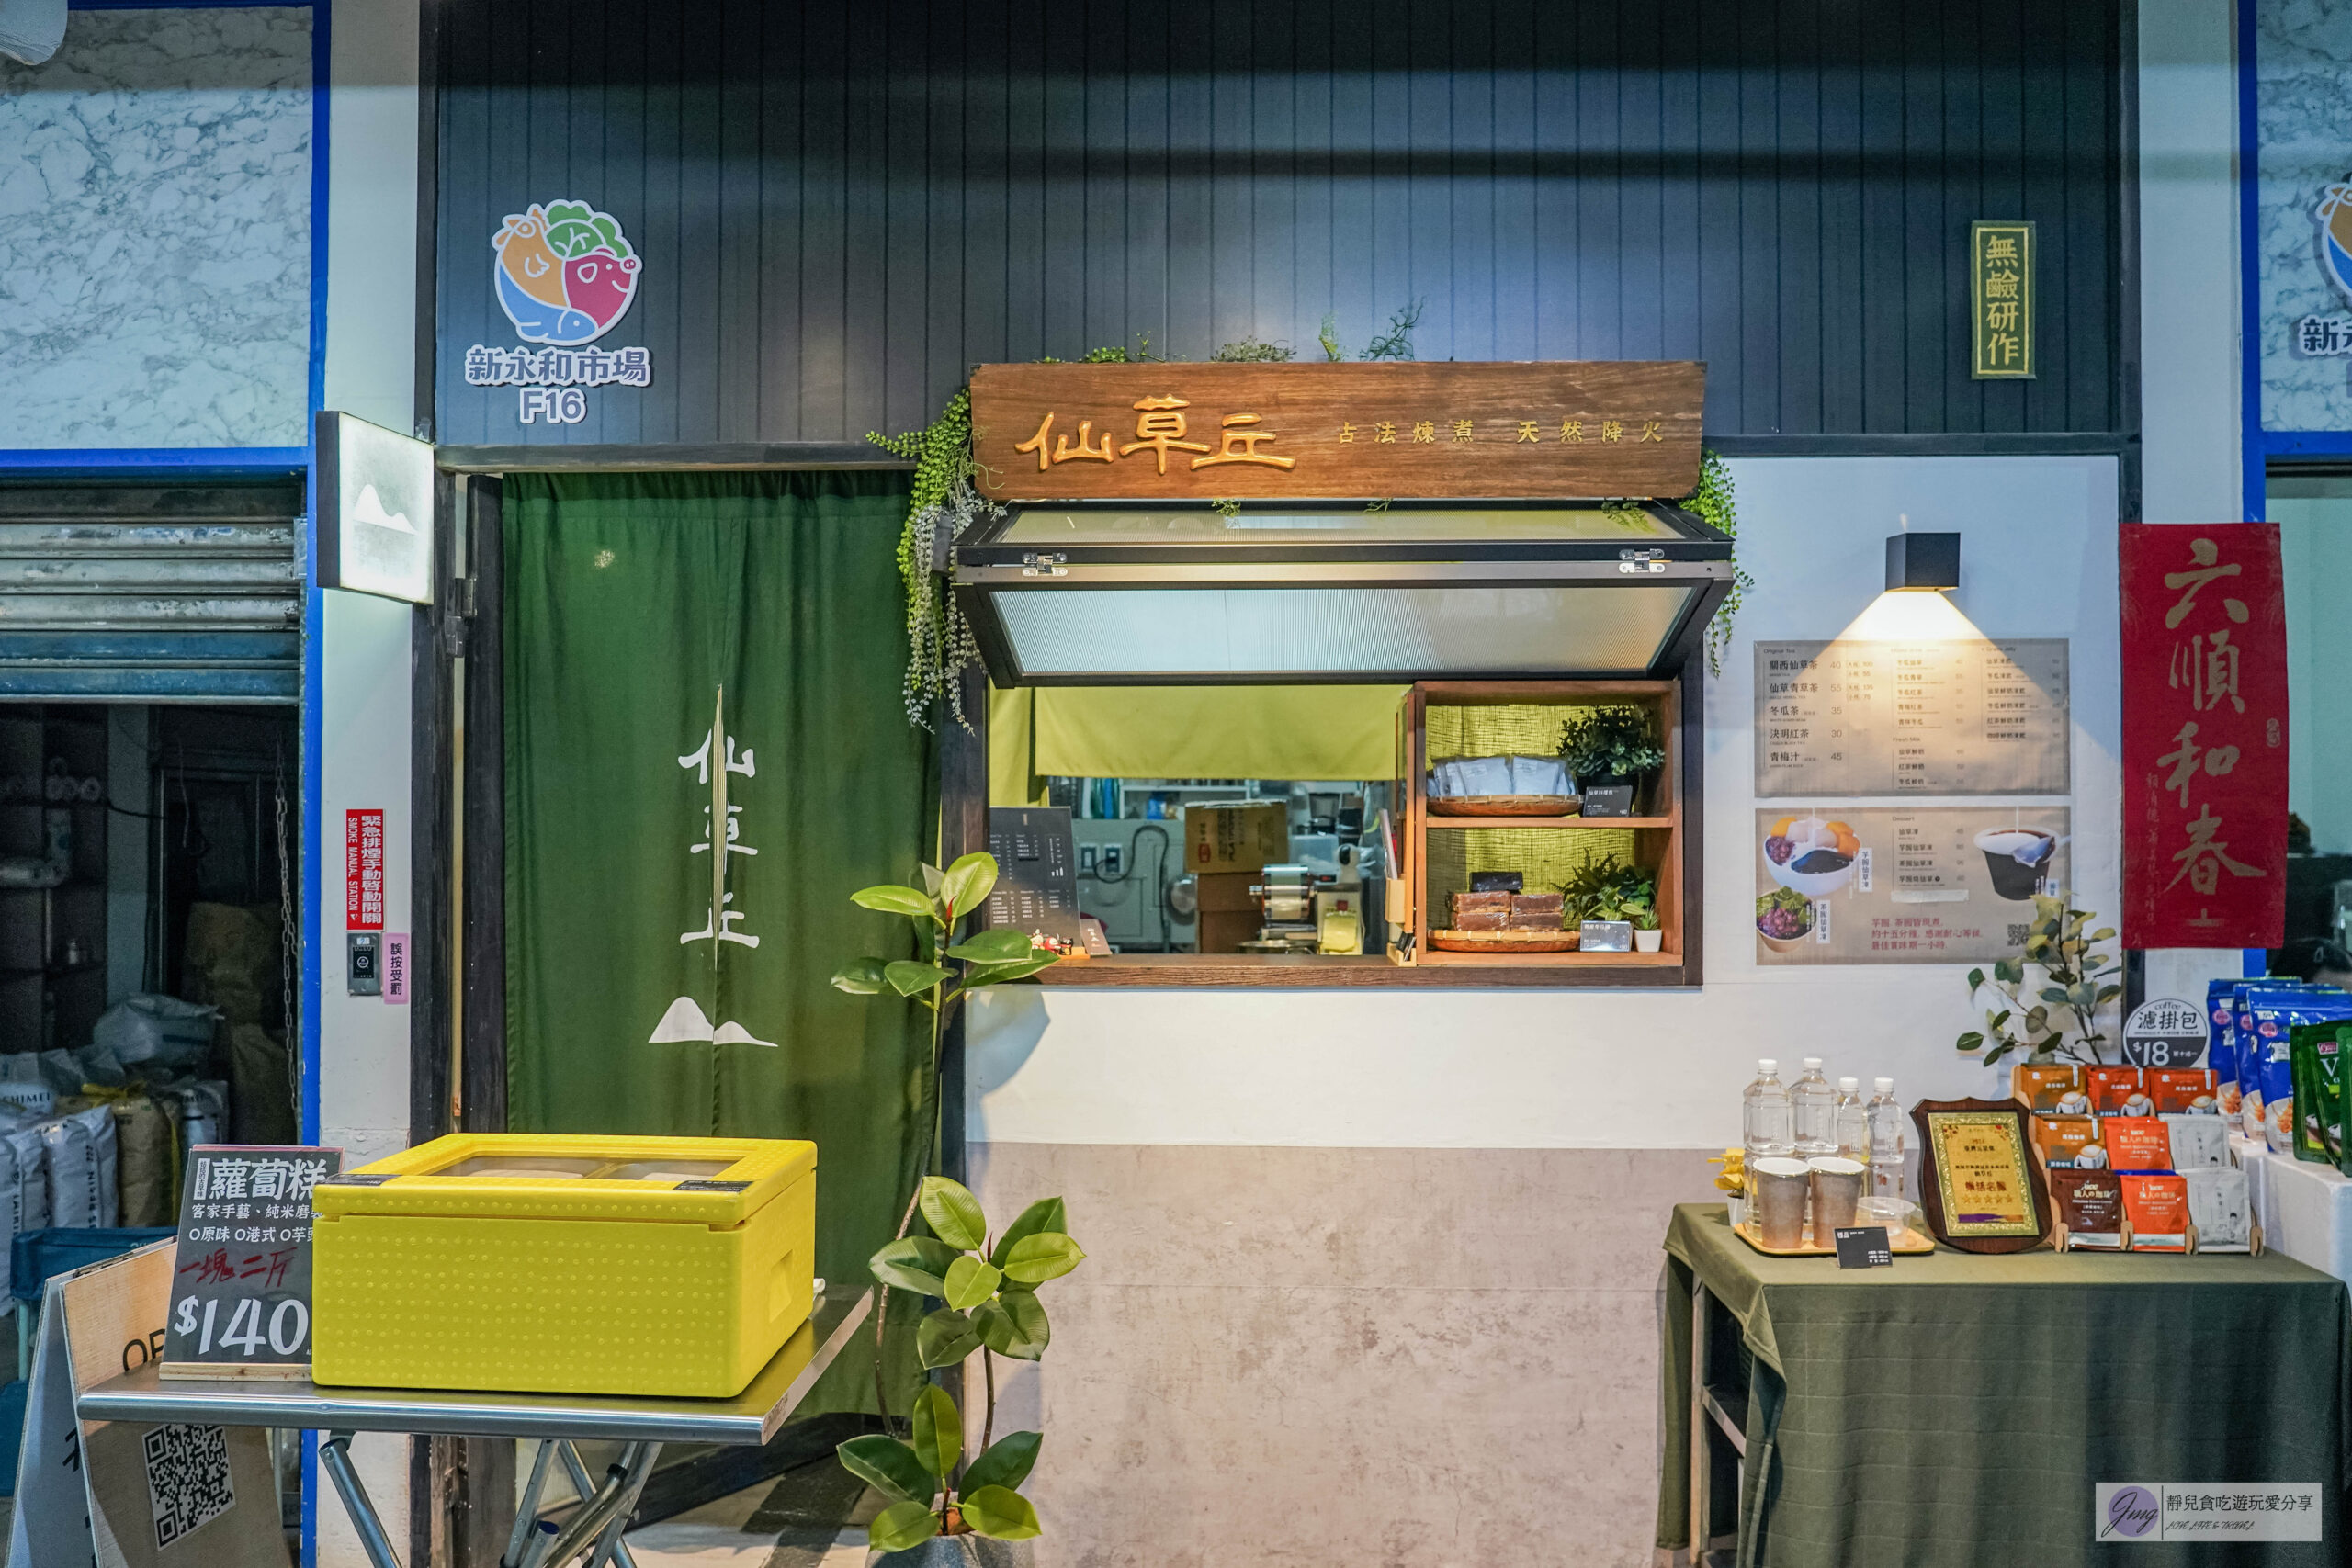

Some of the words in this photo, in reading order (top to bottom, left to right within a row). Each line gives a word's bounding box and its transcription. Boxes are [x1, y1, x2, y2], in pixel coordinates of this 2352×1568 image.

[1985, 234, 2020, 367] 無鹼研作
[467, 348, 648, 383] 新永和市場
[522, 390, 582, 420] F16
[1014, 393, 1297, 476] 仙草丘
[1338, 419, 1475, 445] 古法煉煮
[1516, 420, 1664, 444] 天然降火
[1830, 660, 1842, 670] 40
[1830, 683, 1842, 693] 55
[1770, 705, 1800, 716] 冬瓜茶
[1830, 706, 1843, 715] 35
[2156, 537, 2267, 896] 六順和春
[1770, 728, 1810, 739] 決明紅茶
[1830, 729, 1843, 739] 30
[1770, 751, 1801, 762] 青梅汁
[1830, 752, 1843, 761] 45
[348, 817, 358, 843] SMOKE
[348, 846, 358, 877] MANUAL
[348, 880, 358, 911] STATION
[390, 942, 402, 995] 誤按受罰
[2138, 1010, 2198, 1030] 濾掛包
[2132, 1041, 2170, 1066] $18
[209, 1157, 327, 1201] 蘿蔔糕
[179, 1246, 299, 1288] 一塊二斤
[174, 1294, 309, 1357] $140
